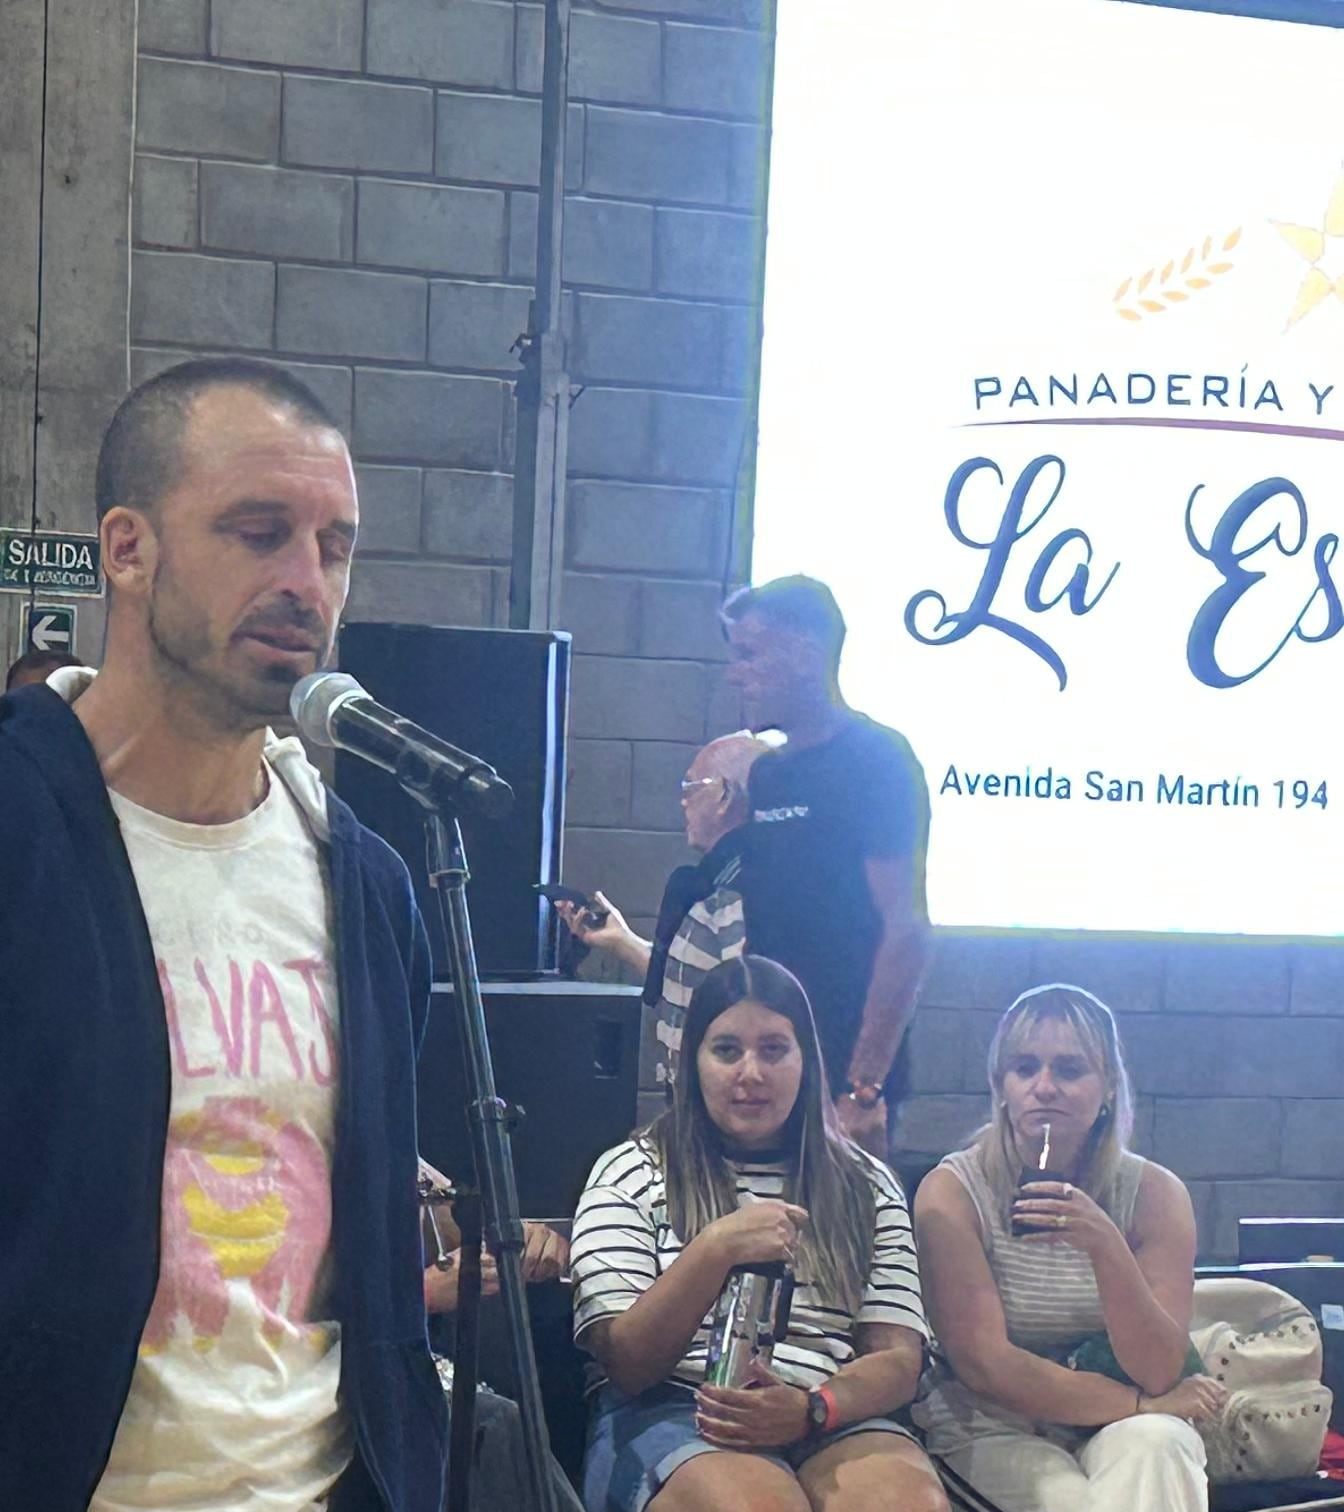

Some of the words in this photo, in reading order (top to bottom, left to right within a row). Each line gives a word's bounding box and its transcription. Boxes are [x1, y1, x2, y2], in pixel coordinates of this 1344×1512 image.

[973, 362, 1285, 420] PANADERÍA
[1307, 381, 1336, 416] Y
[8, 538, 94, 570] SALIDA
[902, 452, 1122, 693] La
[939, 763, 1073, 800] Avenida
[1084, 769, 1145, 803] San
[1272, 778, 1329, 811] 194
